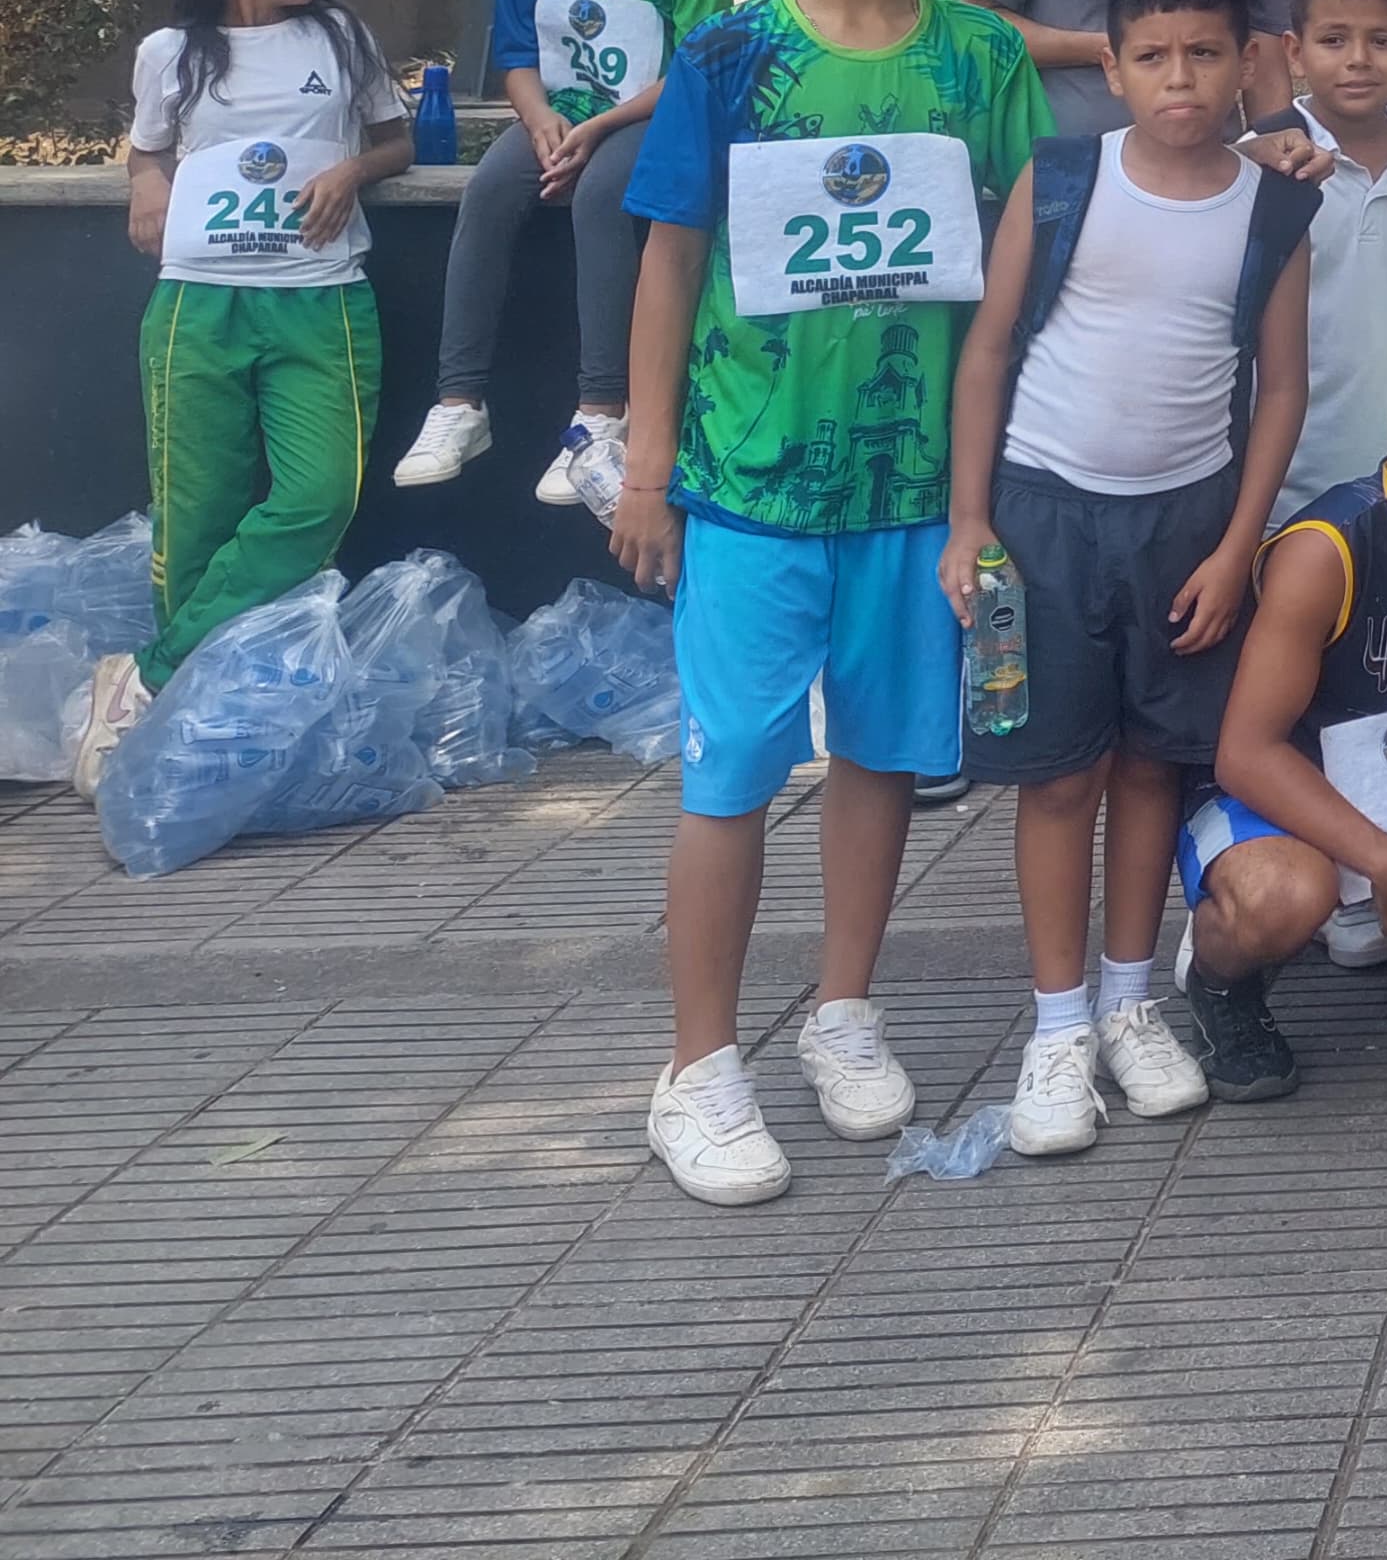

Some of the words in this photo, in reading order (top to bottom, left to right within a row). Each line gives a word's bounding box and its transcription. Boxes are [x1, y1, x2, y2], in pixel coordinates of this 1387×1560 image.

[207, 230, 257, 245] ALCALDÍA
[783, 207, 934, 276] 252
[231, 242, 289, 255] CHAPARRAL
[790, 274, 854, 295] ALCALDÍA
[855, 271, 929, 289] MUNICIPAL
[821, 287, 900, 306] CHAPARRAL
